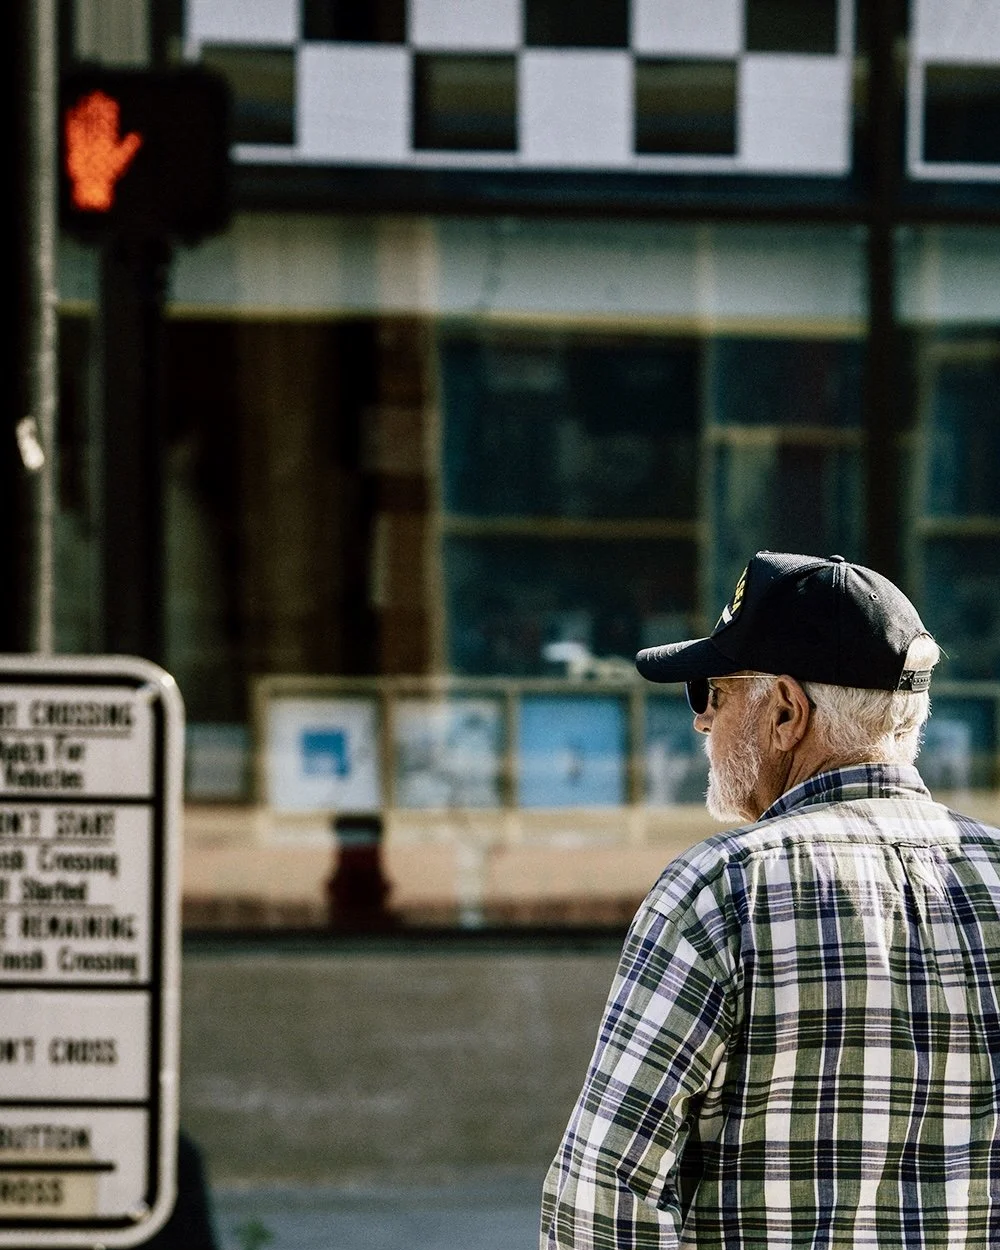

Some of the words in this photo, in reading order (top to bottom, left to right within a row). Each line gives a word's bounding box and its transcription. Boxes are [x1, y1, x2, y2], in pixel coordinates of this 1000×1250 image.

[31, 700, 133, 727] CROSSING
[56, 811, 116, 837] START
[38, 844, 119, 877] Crossing
[21, 877, 88, 900] Started
[20, 913, 137, 940] REMAINING
[57, 946, 139, 979] Crossing
[49, 1037, 118, 1066] CROSS
